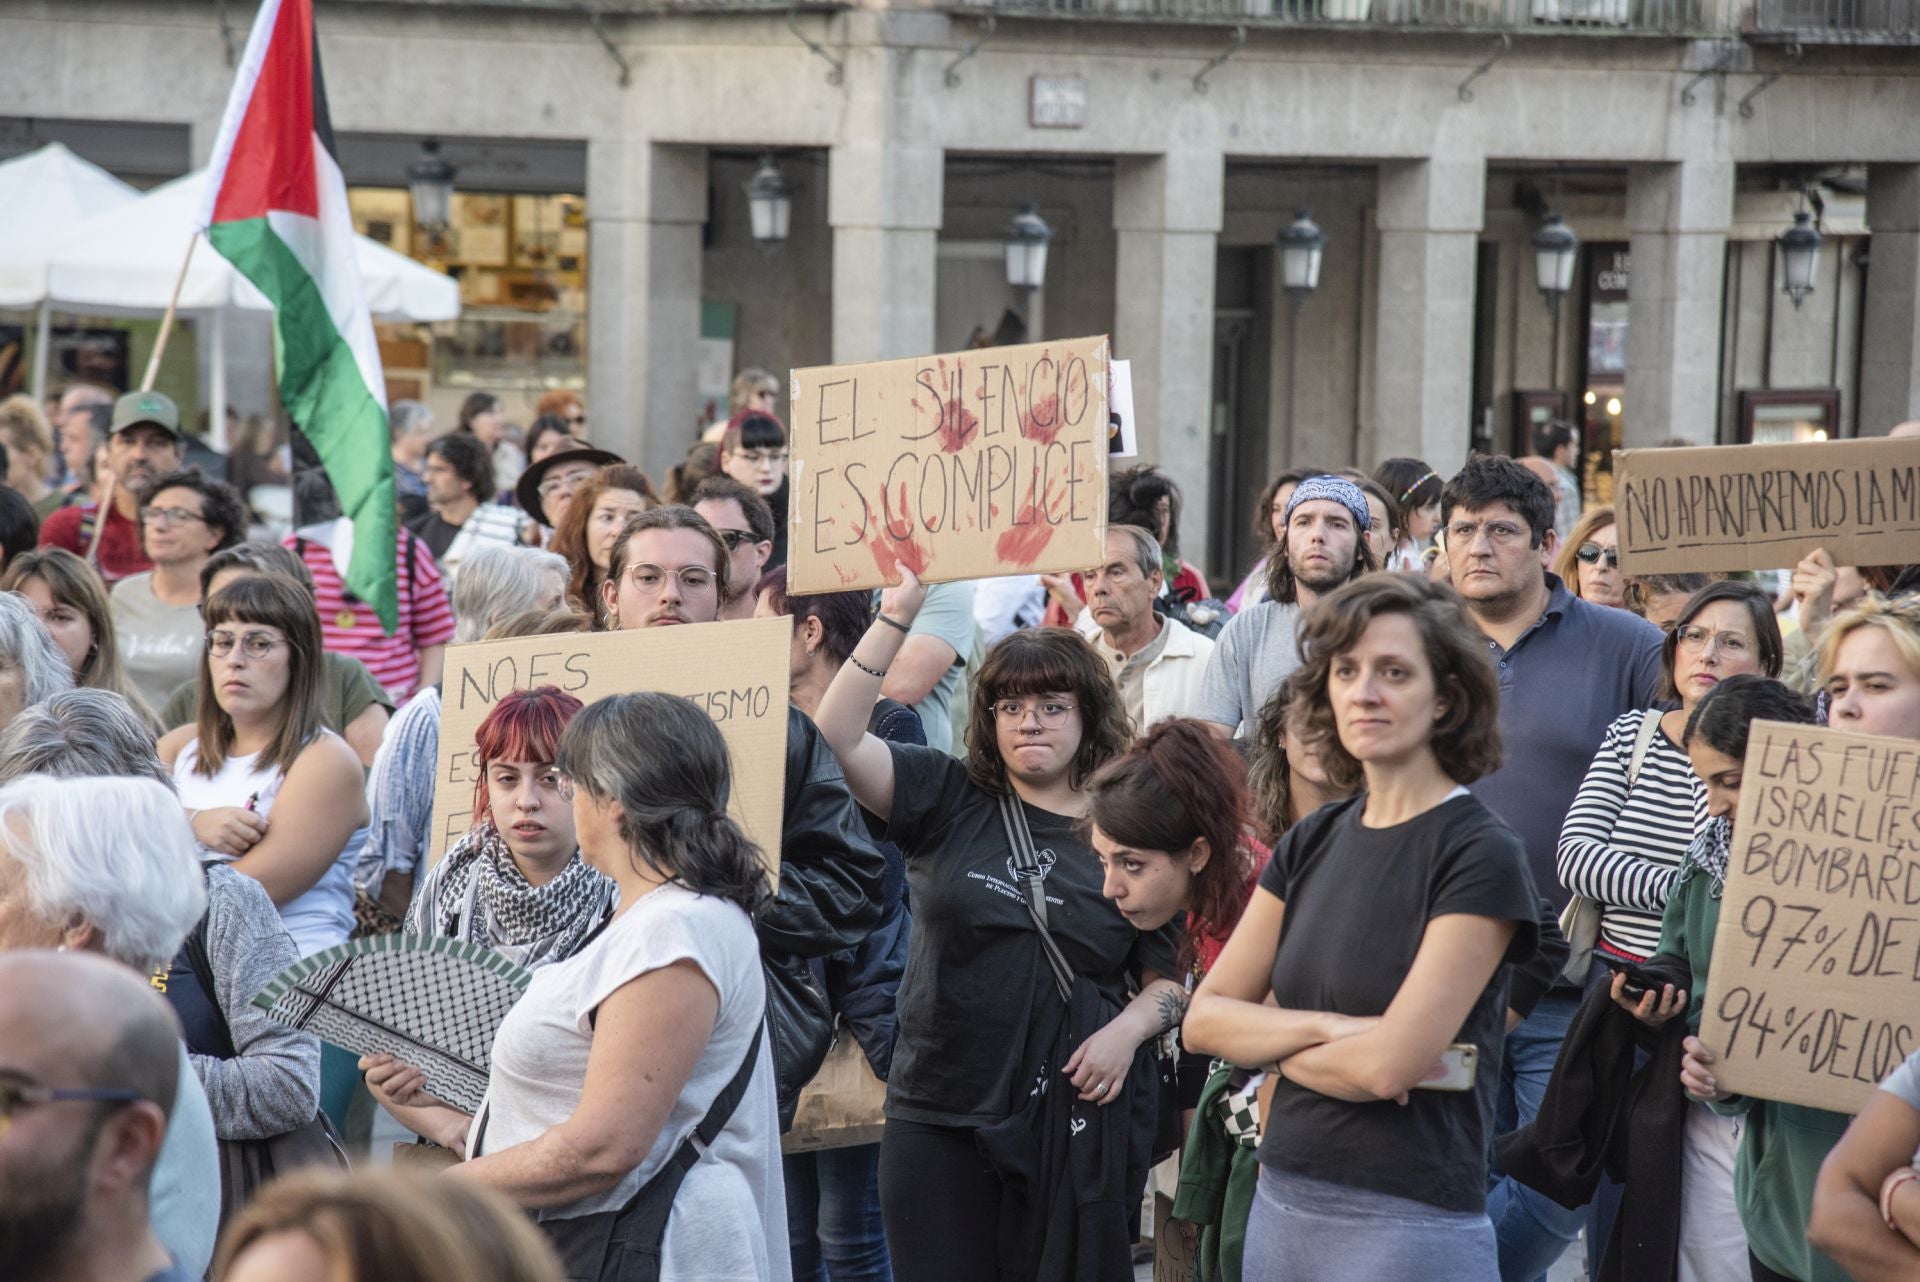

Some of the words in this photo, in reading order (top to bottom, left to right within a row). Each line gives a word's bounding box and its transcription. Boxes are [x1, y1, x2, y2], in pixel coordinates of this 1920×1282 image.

[815, 378, 876, 445] EL
[900, 357, 1089, 441] SILENCIO
[815, 462, 868, 553] ES
[1625, 476, 1670, 547] NO
[1675, 469, 1847, 538] APARTAREMOS
[1854, 469, 1887, 526] LA
[460, 655, 517, 710] NO
[1759, 734, 1824, 786] LAS
[1741, 895, 1848, 975] 97%
[1848, 910, 1919, 977] DE
[1717, 986, 1815, 1060] 94%
